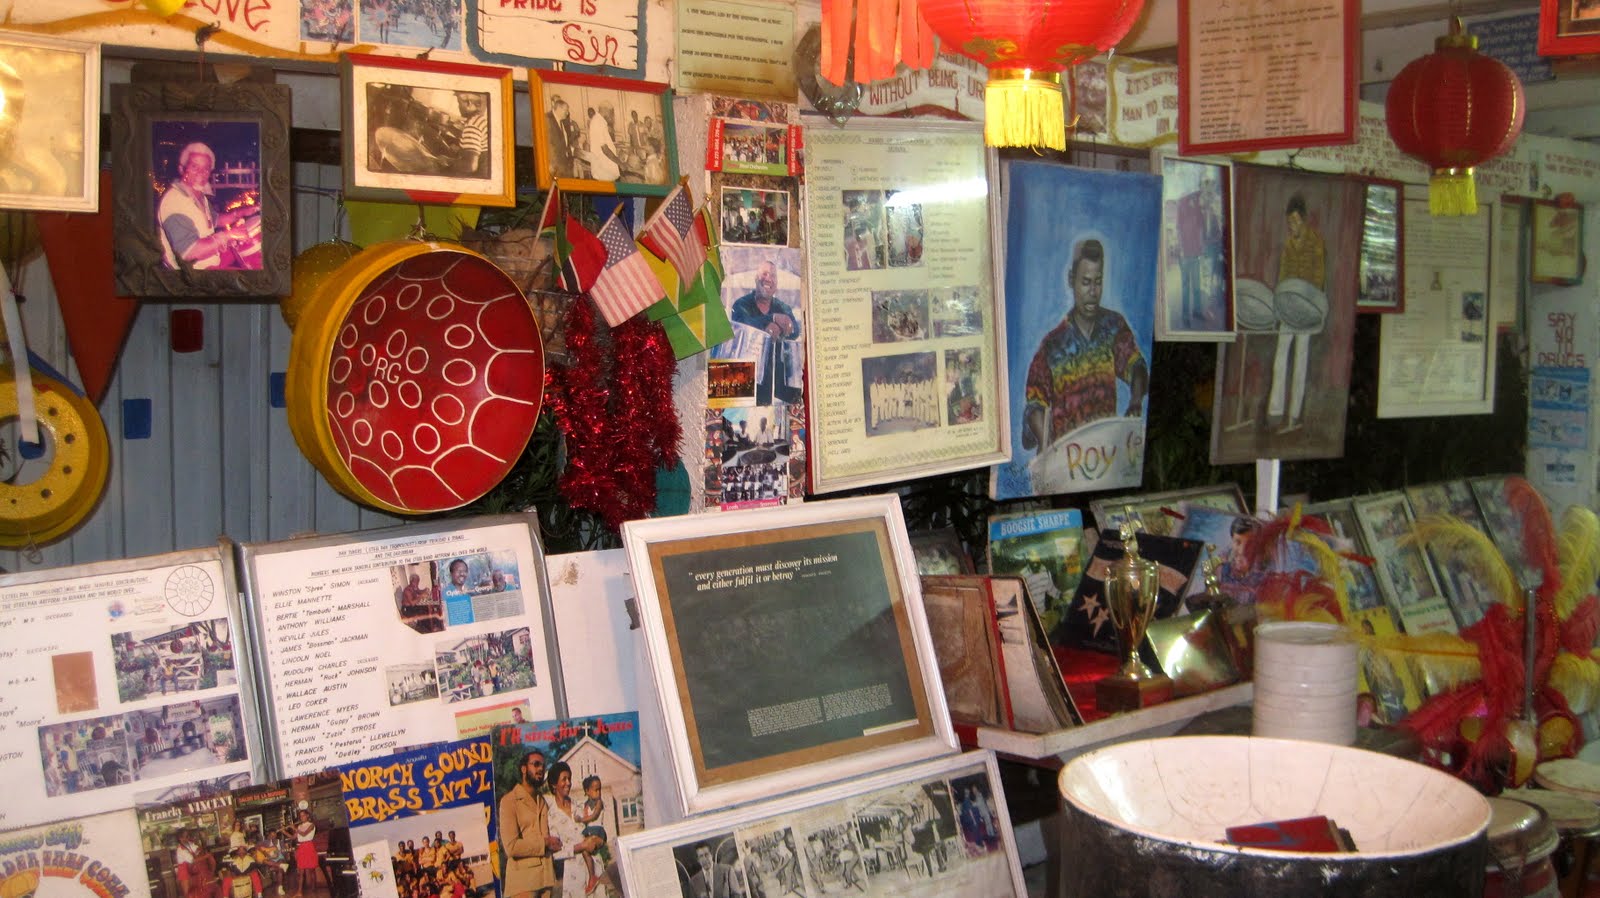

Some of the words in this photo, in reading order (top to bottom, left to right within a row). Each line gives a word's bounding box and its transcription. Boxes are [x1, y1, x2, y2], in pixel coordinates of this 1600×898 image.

[869, 69, 920, 106] WITHOUT
[927, 68, 959, 90] BEING
[967, 75, 985, 101] UR
[1122, 105, 1142, 121] MAN
[1537, 352, 1585, 369] DRUGS
[1000, 518, 1036, 537] BOOGSIE
[716, 564, 753, 579] generation
[755, 562, 773, 573] must
[774, 559, 802, 571] discover
[803, 556, 812, 567] its
[813, 553, 838, 565] mission
[272, 588, 302, 599] WINSTON
[330, 580, 351, 590] SIMON
[696, 580, 711, 592] and
[712, 577, 733, 590] either
[734, 574, 754, 589] fulfil
[755, 573, 762, 584] it
[763, 574, 771, 583] or
[274, 600, 293, 609] ELLIE
[297, 594, 333, 606] MANNETTE
[276, 611, 299, 622] BERTIE
[337, 600, 372, 612] MARSHALL
[277, 621, 308, 632] ANTHONY
[314, 614, 346, 625] WILLIAMS
[278, 632, 306, 643] NEVILLE
[309, 629, 330, 638] JULES
[280, 645, 302, 654] JAMES
[339, 633, 369, 644] JACKMAN
[281, 655, 310, 665] LINCOLN
[315, 651, 332, 660] NOEL
[283, 666, 314, 677] RUDOLPH
[318, 660, 348, 671] CHARLES
[284, 677, 313, 688] HERMAN
[346, 665, 377, 677] JOHNSON
[286, 687, 317, 699] WALLACE
[323, 682, 348, 692] AUSTIN
[288, 702, 302, 711] LEO
[305, 697, 328, 708] COKER
[290, 710, 330, 723] LAWERENCE
[336, 703, 359, 713] MYERS
[291, 723, 321, 734] HERMAN
[357, 710, 381, 721] BROWN
[293, 735, 317, 745] KALVIN
[351, 722, 377, 733] STROSE
[294, 745, 325, 757] FRANCIS
[369, 728, 407, 743] LLEWELLYN
[296, 755, 328, 767] RUDOLPH
[369, 740, 399, 753] DICKSON
[340, 762, 416, 793] NORTH
[423, 742, 493, 787] SOUND
[188, 795, 234, 813] VINCENT
[346, 788, 424, 823] BRASS
[428, 770, 491, 809] INT'L
